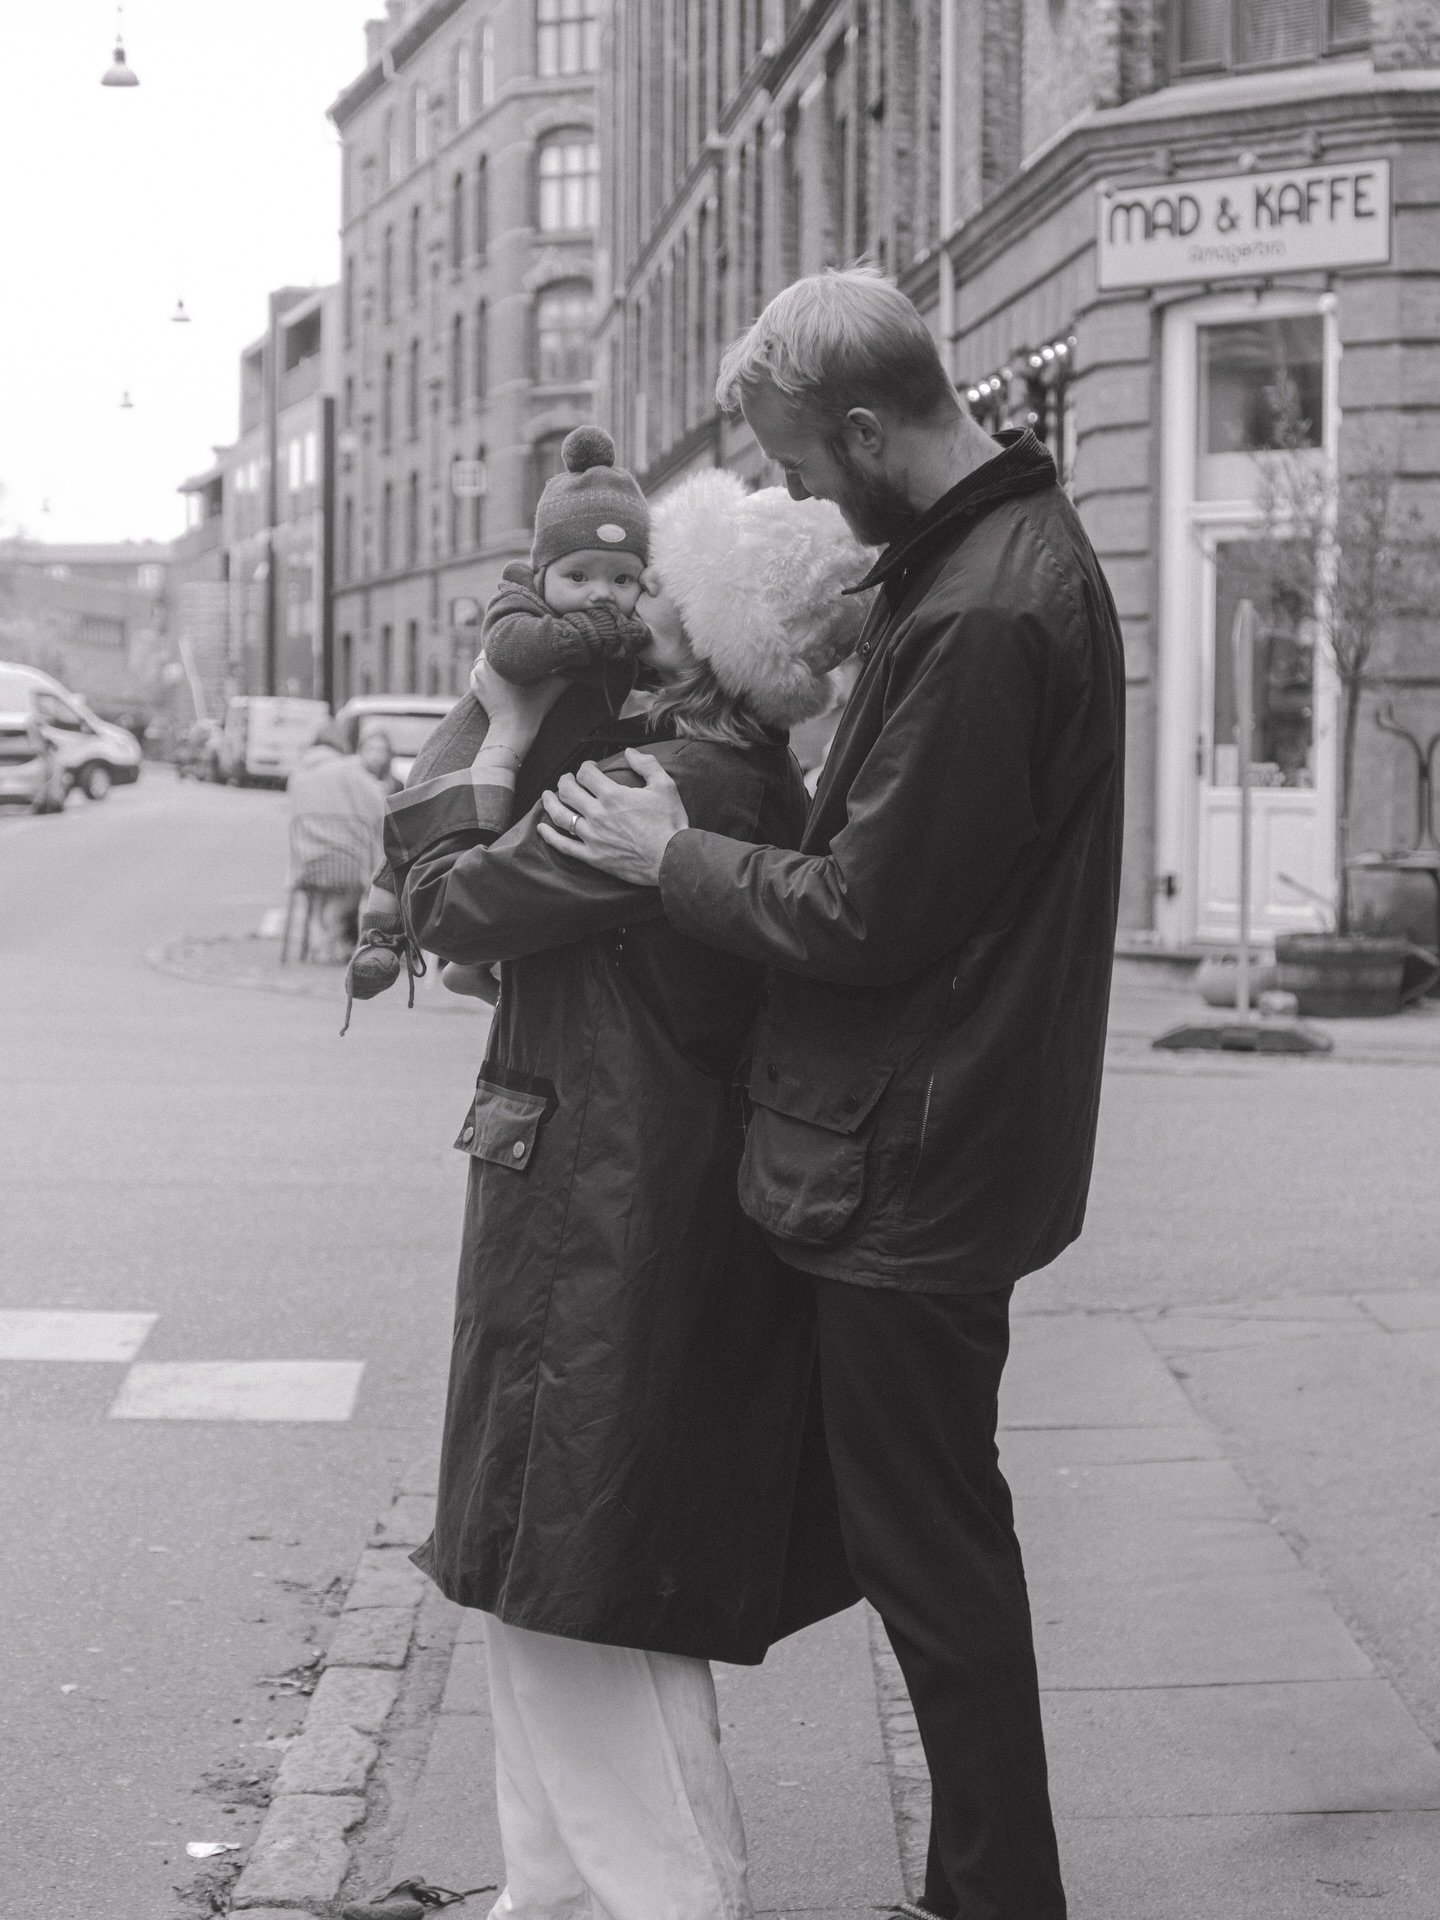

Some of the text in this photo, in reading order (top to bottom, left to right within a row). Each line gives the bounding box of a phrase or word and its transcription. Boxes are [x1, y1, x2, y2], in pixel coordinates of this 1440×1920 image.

[1109, 172, 1376, 243] MAD & KAFFE
